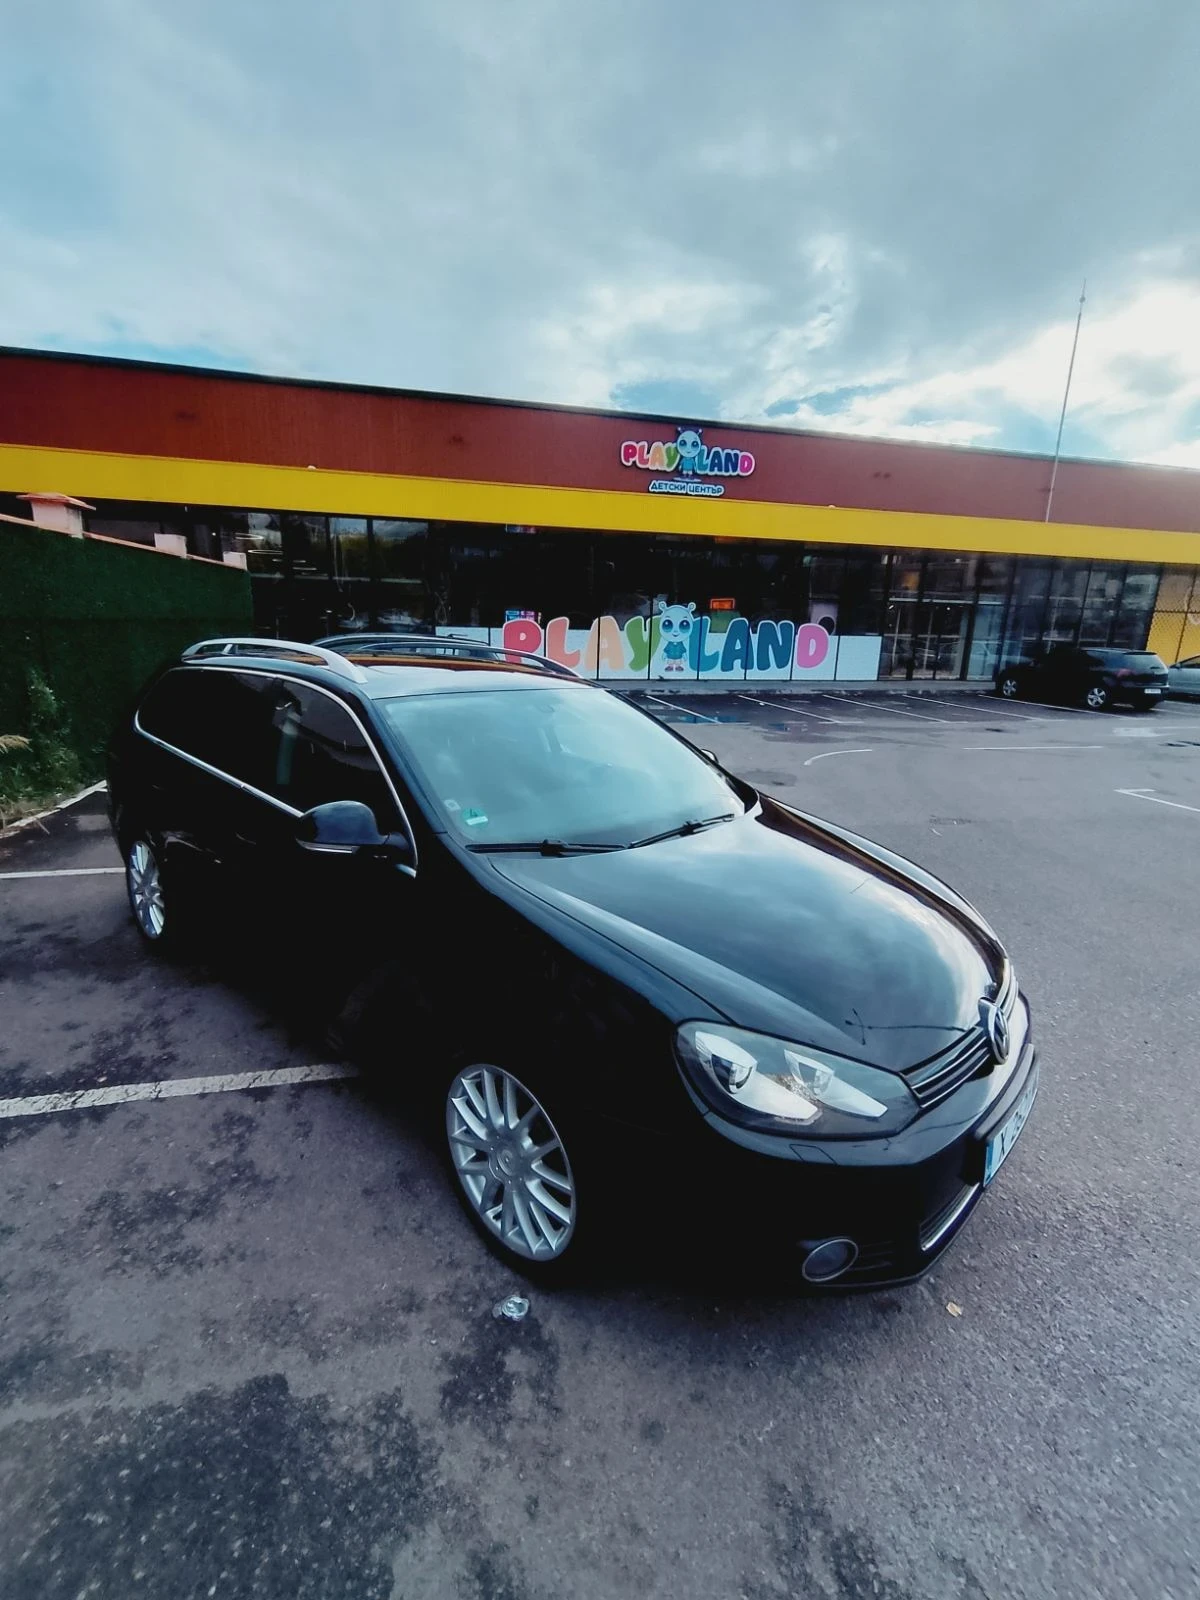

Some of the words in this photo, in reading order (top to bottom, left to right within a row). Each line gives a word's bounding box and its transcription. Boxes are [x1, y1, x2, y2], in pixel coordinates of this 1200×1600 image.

[621, 441, 680, 472] PLAY
[696, 445, 755, 476] LAND
[650, 481, 686, 494] ДЕТСКИ
[688, 484, 723, 496] ЦЕНТЪР
[502, 616, 660, 673] PLAY
[692, 616, 830, 673] LAND
